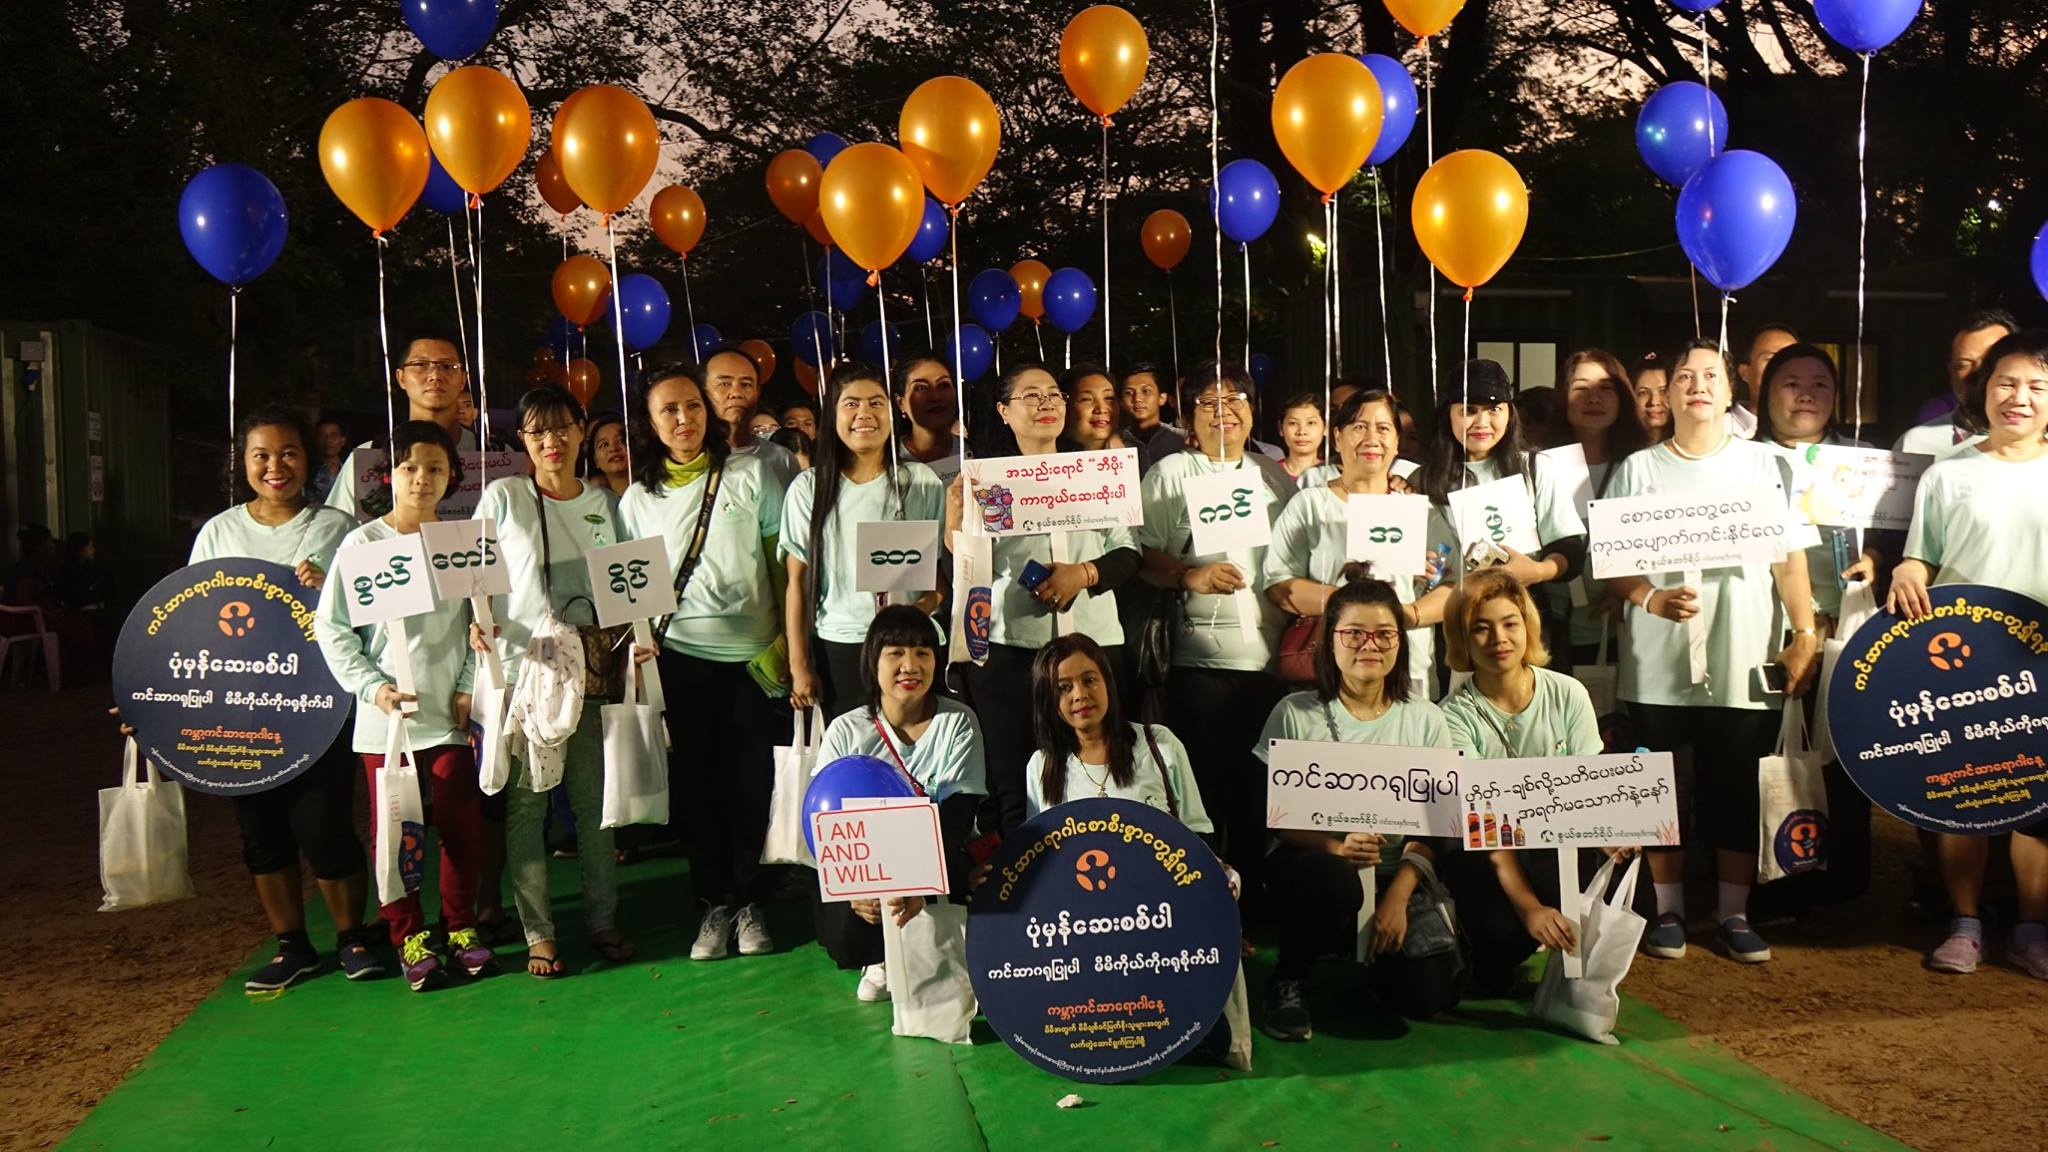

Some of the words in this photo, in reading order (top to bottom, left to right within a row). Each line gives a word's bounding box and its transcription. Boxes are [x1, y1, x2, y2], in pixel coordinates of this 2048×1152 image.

[1006, 459, 1084, 482] အသည်းရောင်
[1020, 484, 1126, 509] ကာကွယ်ဆေးထိုးပါ
[1200, 488, 1254, 524] ကင်
[1370, 527, 1402, 543] အ
[431, 537, 497, 569] တော်
[870, 549, 921, 565] ဆာ
[353, 555, 413, 606] စွယ်
[608, 559, 650, 603] ရိပ်
[169, 649, 299, 679] ပုံမှန်ဆေးစစ်ပါ
[131, 687, 214, 709] ကင်ဆာဂရုပြုပါ
[225, 691, 334, 713] မိမိကိုယ်ကိုဂရုစိုက်ပါ
[1889, 669, 2038, 728] ပုံမှန်ဆေးစစ်ပါ
[1859, 730, 1952, 760] ကင်ဆာဂရုပြုပါ
[1272, 762, 1459, 804] ကင်ဆာဂရုပြုပါ
[1518, 778, 1670, 822] အရက်မသောက်နဲ့နော်
[817, 824, 823, 841] I
[830, 821, 866, 840] AM
[820, 842, 870, 863] AND
[823, 868, 828, 885] I
[835, 864, 892, 884] WILL
[1026, 902, 1173, 948] ပုံမှန်ဆေးစစ်ပါ
[988, 957, 1081, 982] ကင်ဆာဂရုပြုပါ
[1094, 947, 1220, 977] မိမိကိုယ်ကိုဂရုစိုက်ပါ
[1047, 995, 1166, 1020] ကမ္ဘာ့ကင်ဆာရောဂါနေ့
